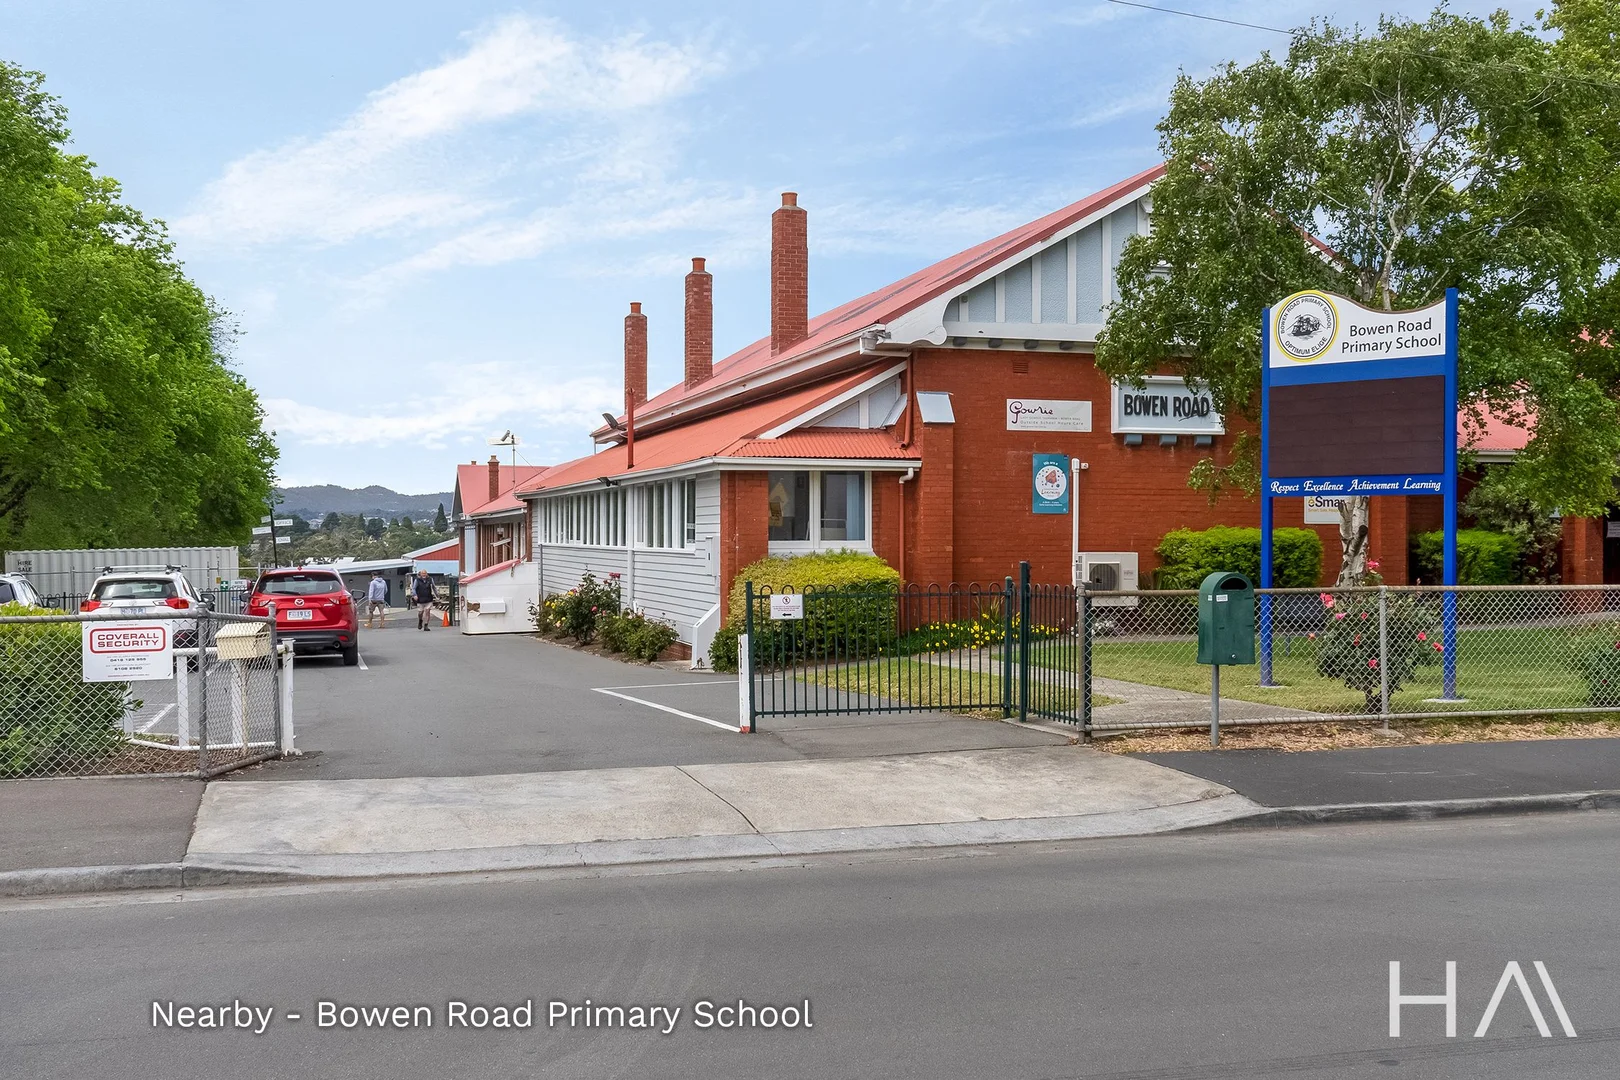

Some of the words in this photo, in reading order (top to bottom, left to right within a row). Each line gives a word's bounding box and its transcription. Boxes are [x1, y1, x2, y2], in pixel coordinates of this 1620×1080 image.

[1280, 312, 1289, 334] BOWEN
[1287, 300, 1301, 314] ROAD
[1301, 297, 1324, 308] PRIMARY
[1322, 306, 1332, 330] SCHOOL
[1349, 322, 1394, 337] Bowen
[1397, 317, 1432, 333] Road
[1284, 340, 1311, 355] OPTIMUM
[1341, 336, 1392, 354] Primary
[1395, 333, 1442, 350] School
[1009, 400, 1054, 425] Gowrie
[1123, 394, 1168, 416] BOWEN
[1173, 396, 1210, 417] ROAD
[1270, 480, 1299, 494] Respect
[1303, 480, 1344, 493] Excellence
[1347, 478, 1399, 492] Achievement
[1403, 477, 1441, 491] Learning
[97, 632, 159, 641] COVERALL
[97, 640, 159, 648] SECURITY
